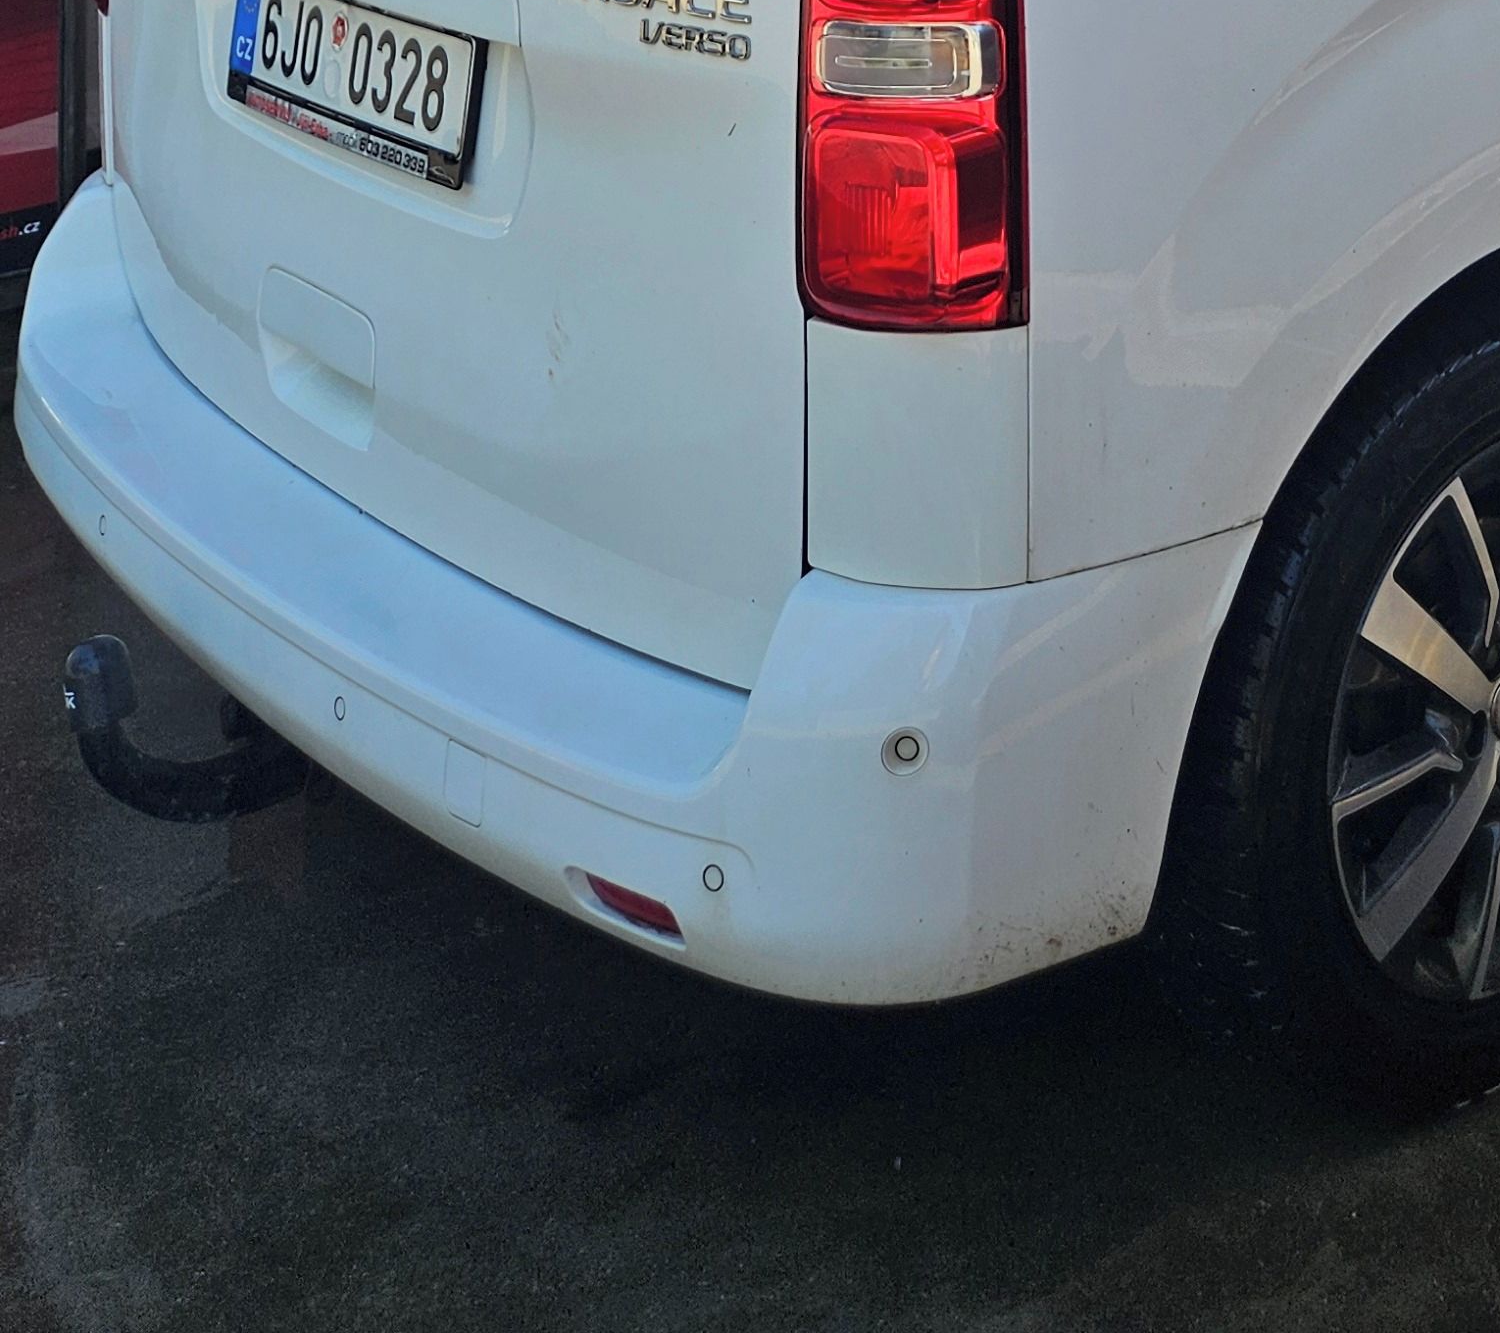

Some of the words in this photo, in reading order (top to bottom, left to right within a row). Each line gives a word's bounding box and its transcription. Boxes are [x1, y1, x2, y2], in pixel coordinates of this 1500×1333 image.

[236, 36, 253, 60] CZ
[639, 18, 752, 61] VERSO
[349, 22, 449, 132] 0328
[359, 136, 380, 157] 603
[381, 144, 401, 166] 220
